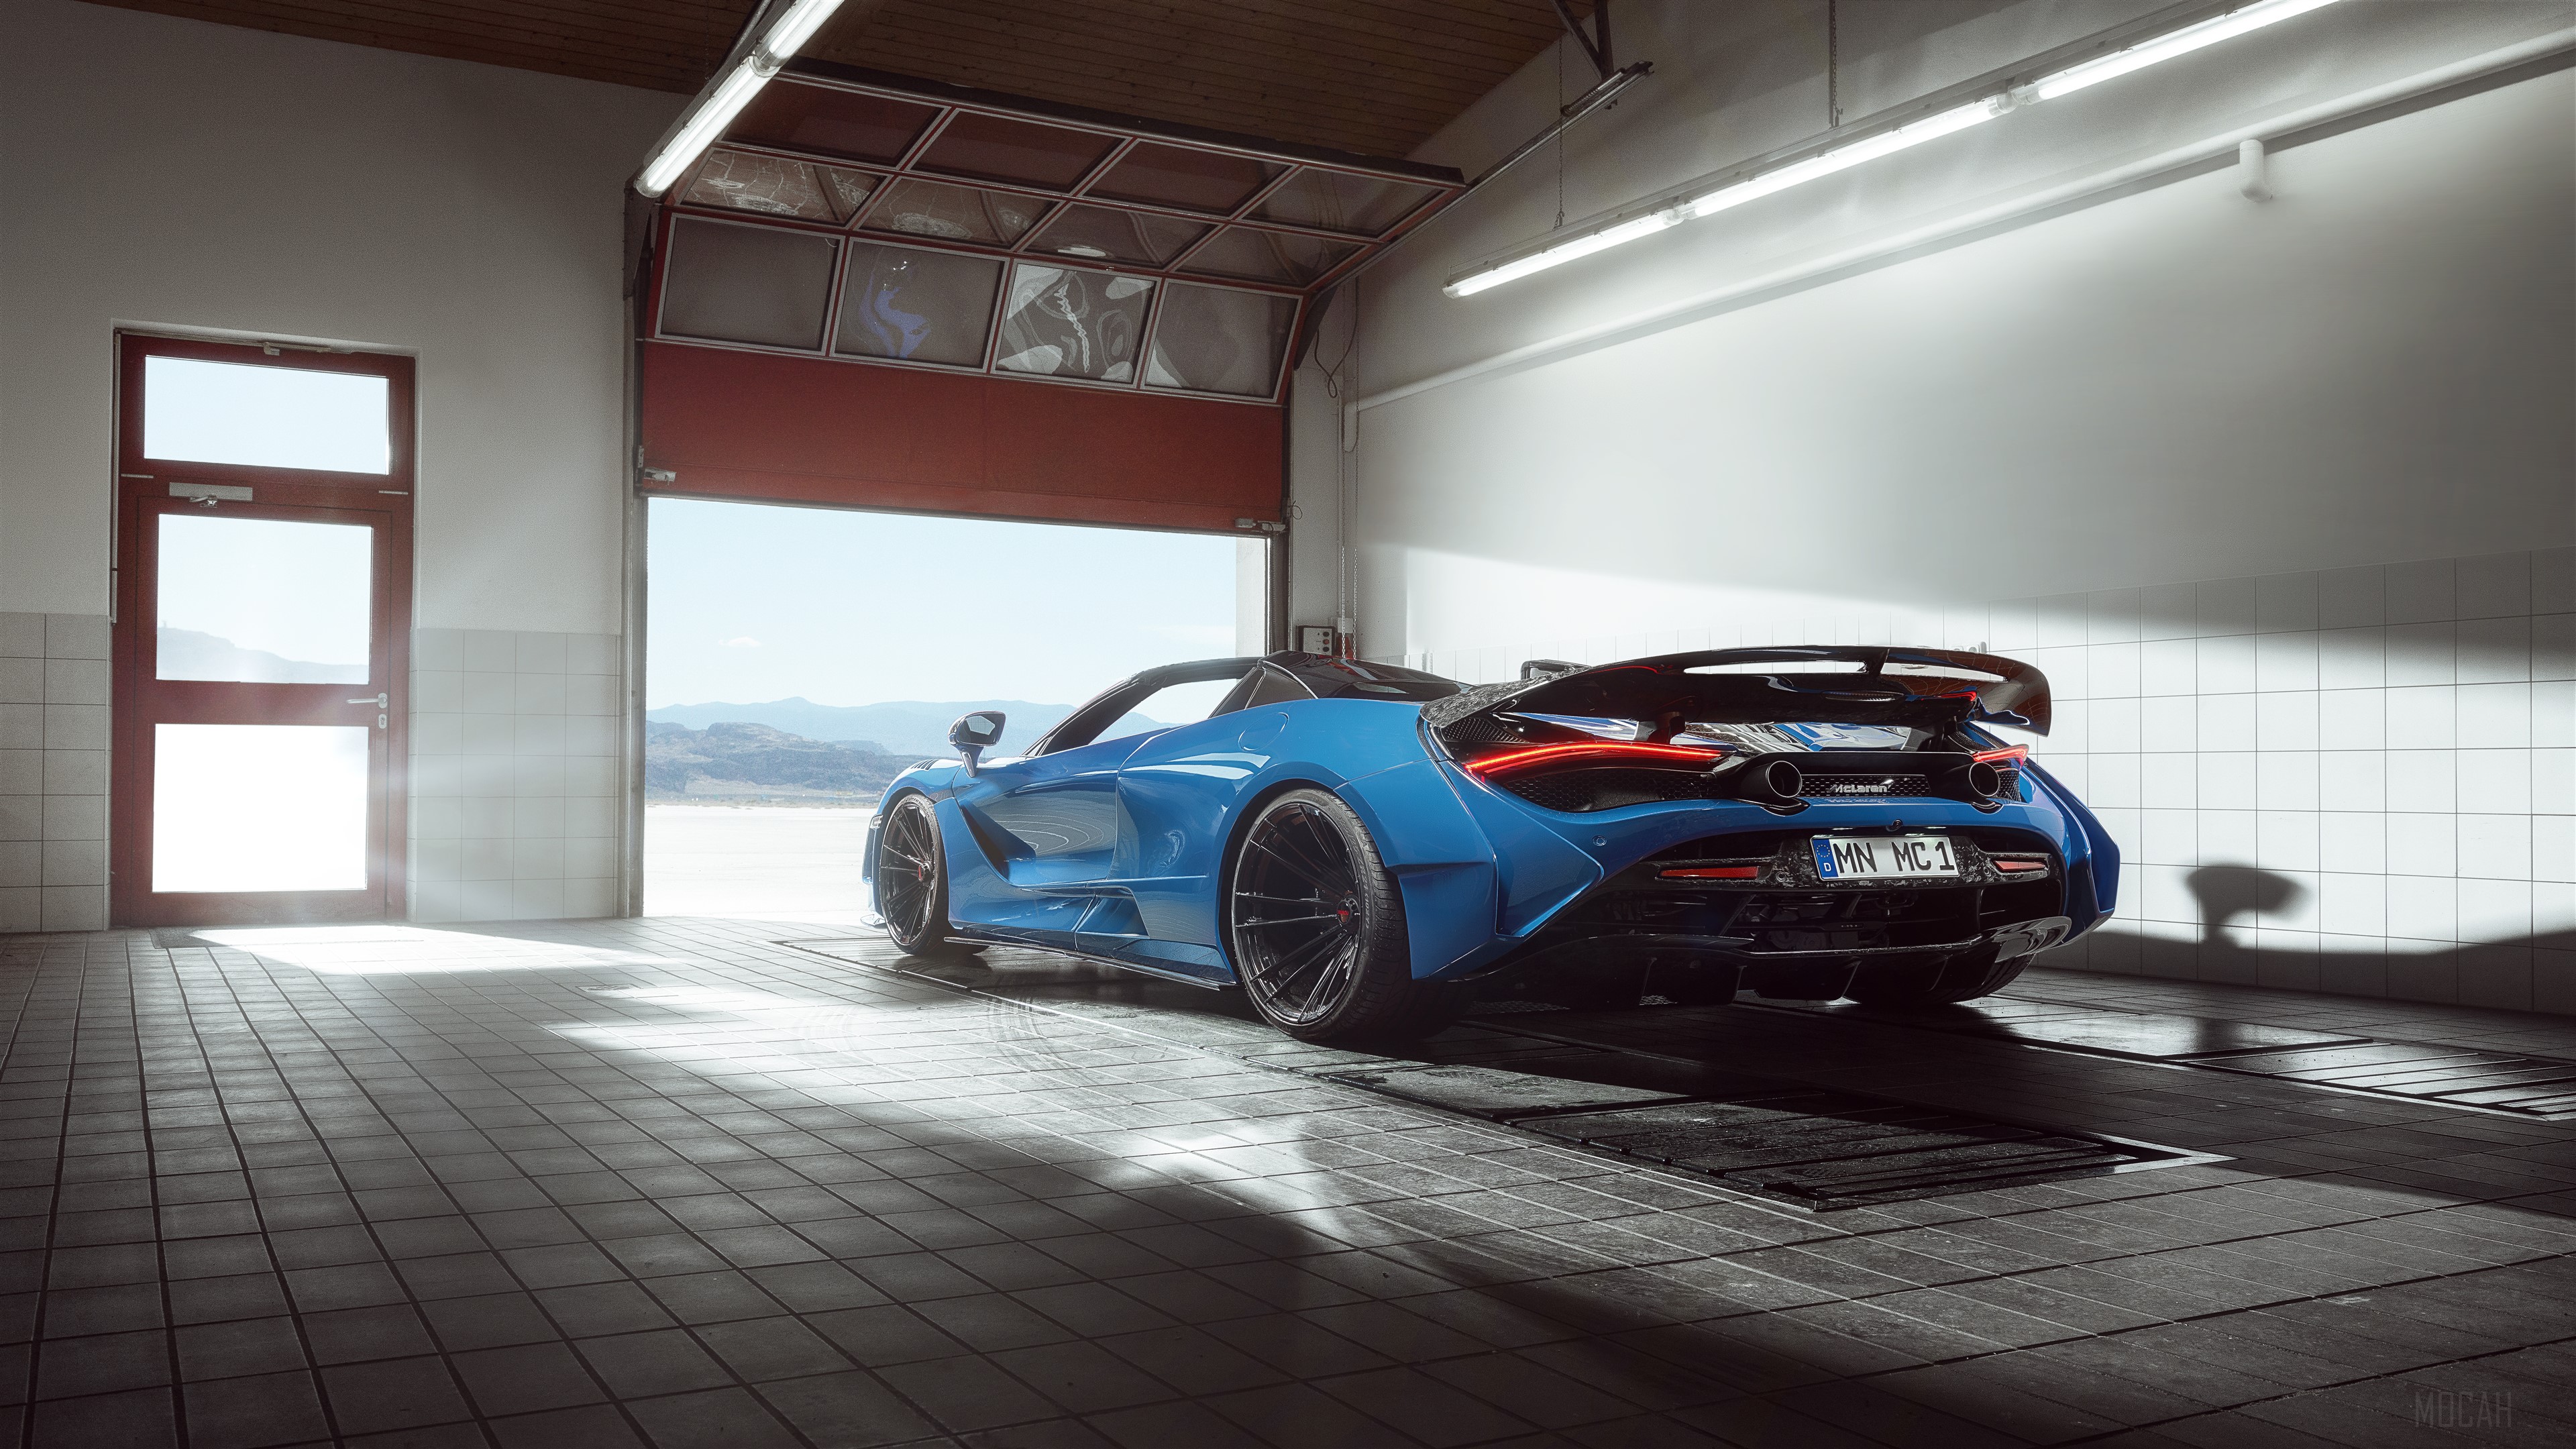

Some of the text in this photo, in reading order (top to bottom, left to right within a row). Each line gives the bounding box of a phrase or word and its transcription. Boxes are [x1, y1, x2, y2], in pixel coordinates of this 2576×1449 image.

[1827, 784, 1888, 793] McLaren
[1833, 841, 1955, 873] MN MC 1
[1823, 863, 1831, 872] D
